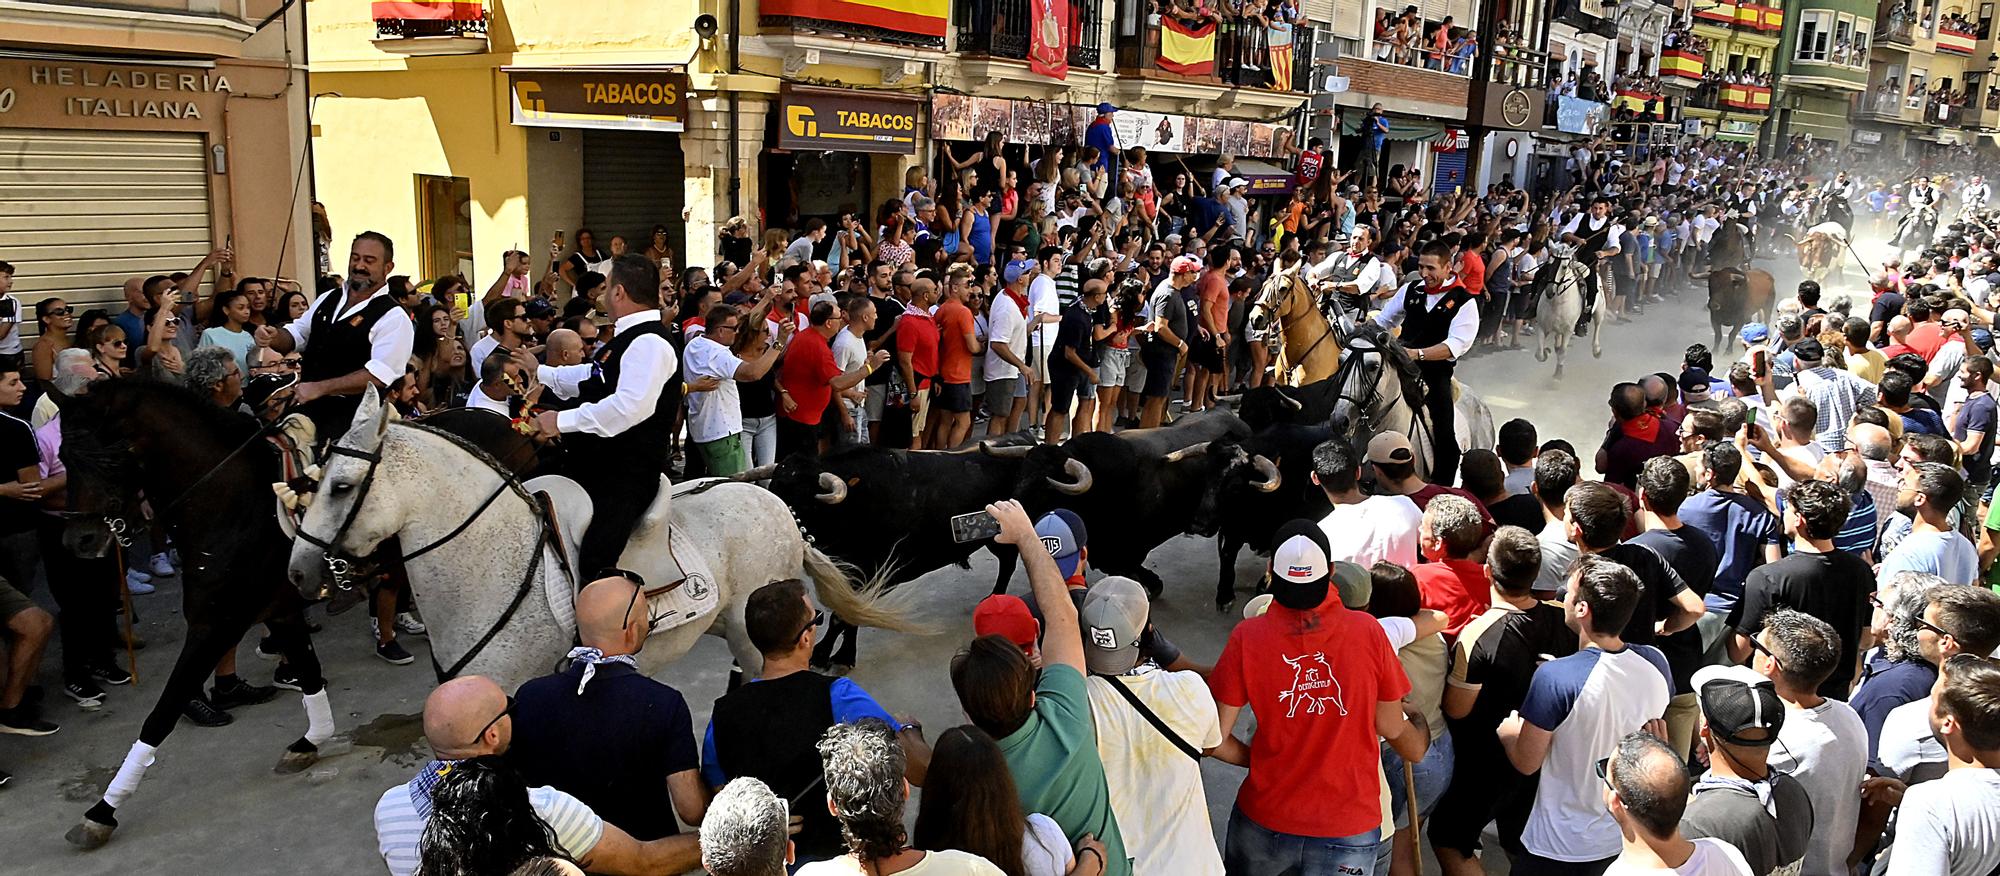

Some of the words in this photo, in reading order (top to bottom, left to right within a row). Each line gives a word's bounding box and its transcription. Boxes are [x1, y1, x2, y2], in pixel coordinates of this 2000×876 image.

[31, 66, 232, 92] HELADERIA
[583, 83, 677, 105] TABACOS
[66, 97, 201, 120] ITALIANA
[837, 110, 914, 131] TABACOS
[1302, 163, 1318, 178] 23
[1042, 539, 1060, 554] EUS
[1338, 864, 1364, 876] FILA
